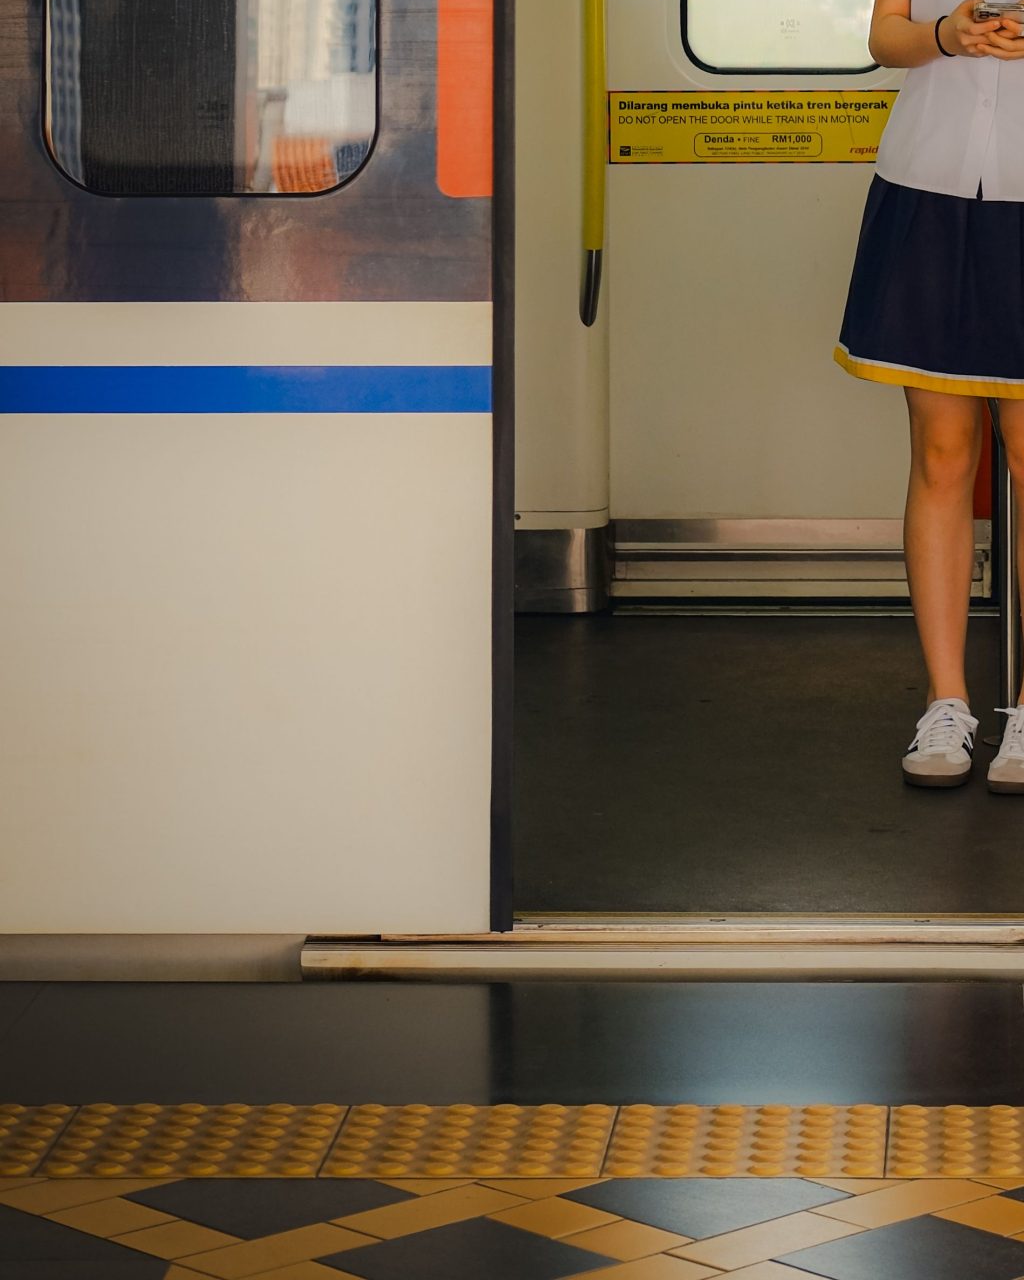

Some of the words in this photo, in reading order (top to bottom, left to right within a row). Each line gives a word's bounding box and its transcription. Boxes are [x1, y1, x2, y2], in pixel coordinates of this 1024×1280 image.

[619, 101, 668, 112] Dilarang
[671, 101, 730, 110] membuka
[733, 101, 763, 112] pintu
[767, 101, 803, 110] ketika
[807, 101, 831, 110] tren
[835, 100, 888, 111] bergerak
[619, 115, 635, 124] DO
[636, 115, 656, 124] NOT
[658, 115, 687, 124] OPEN
[689, 115, 708, 124] THE
[711, 115, 740, 124] DOOR
[742, 115, 773, 124] WHILE
[776, 115, 805, 124] TRAIN
[807, 115, 815, 124] IS
[818, 115, 828, 124] IN
[831, 115, 870, 124] MOTION
[704, 135, 734, 143] Denda
[772, 135, 812, 144] RM1,000
[849, 145, 879, 155] rapid
